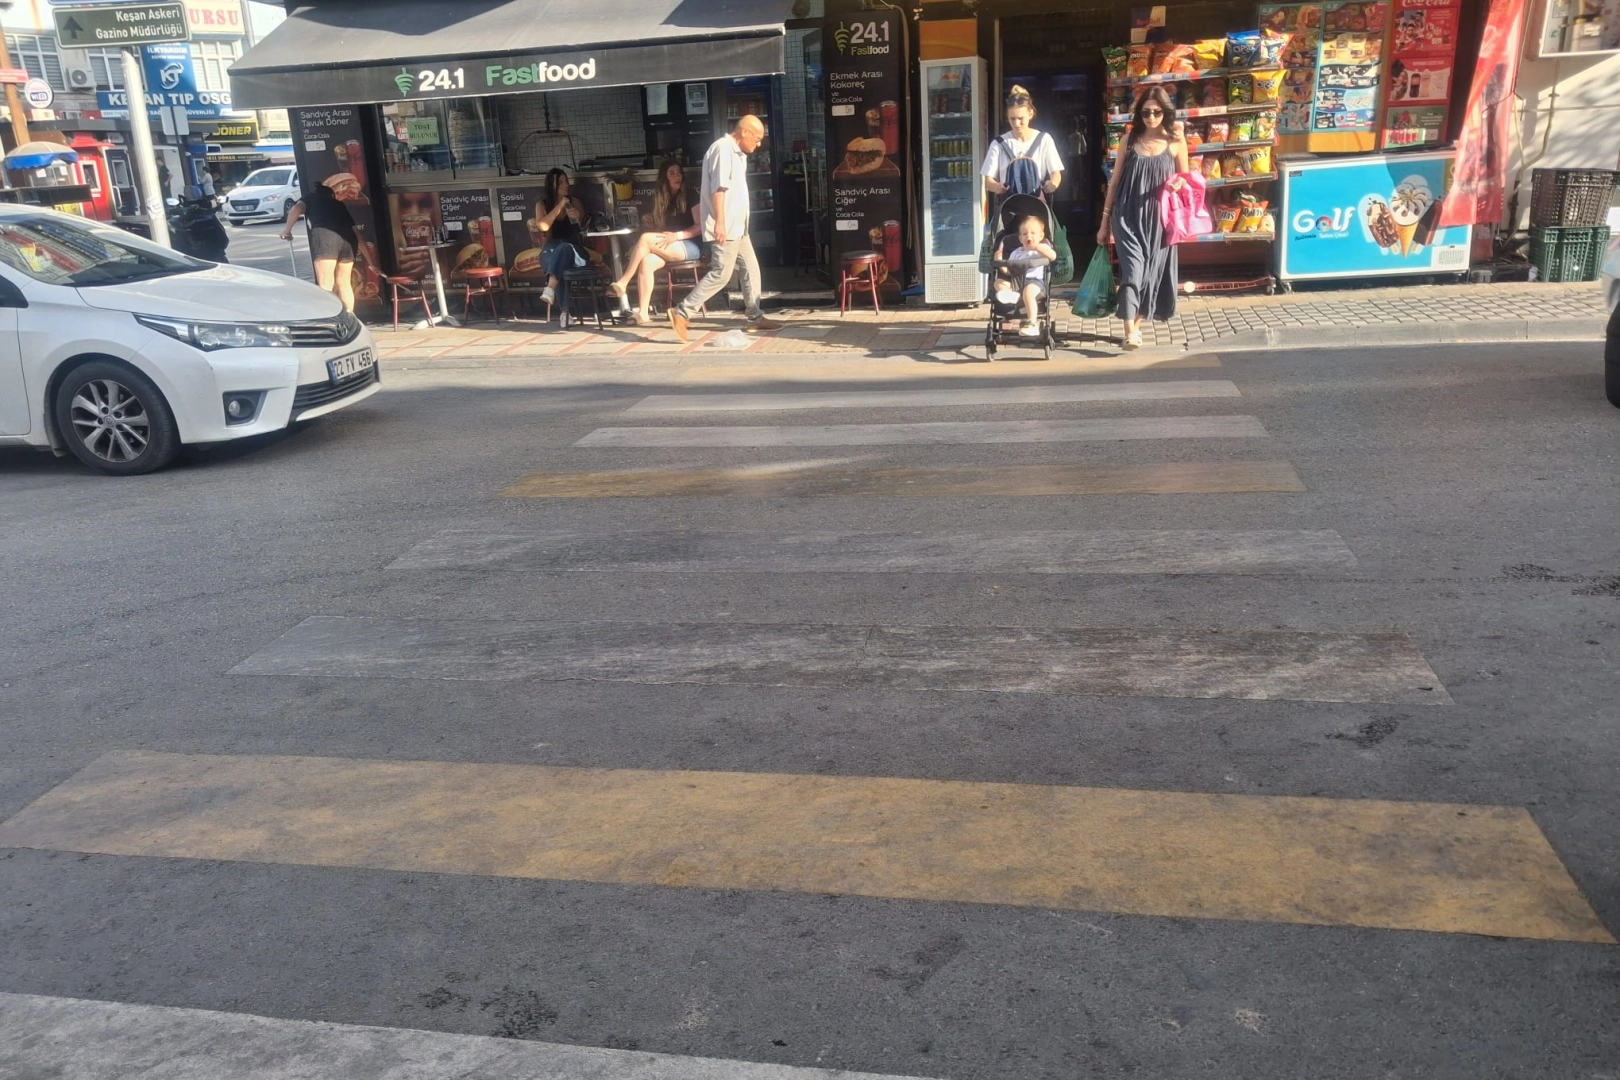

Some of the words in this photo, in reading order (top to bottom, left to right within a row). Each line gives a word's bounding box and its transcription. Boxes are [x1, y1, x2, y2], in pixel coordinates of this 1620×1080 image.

[116, 11, 146, 24] Keşan
[149, 7, 180, 19] Askeri
[96, 28, 128, 39] Gazino
[130, 23, 183, 38] Müdürlüğü
[850, 21, 890, 44] 24.1
[851, 44, 890, 56] Fastfood
[418, 67, 465, 92] 24.1
[485, 57, 596, 86] Fastfood
[830, 71, 859, 81] Ekmek
[861, 70, 883, 79] Arası
[830, 81, 865, 89] Kokoreç
[108, 93, 165, 106] KEAN
[168, 93, 194, 105] TIP
[831, 96, 863, 104] Coca-Cola
[300, 110, 331, 120] Sandviç
[332, 109, 352, 117] Arası
[301, 119, 325, 128] Tavuk
[326, 117, 350, 126] Döner
[834, 187, 867, 197] Sandviç
[869, 186, 891, 195] Arası
[440, 195, 469, 204] Sandviç
[470, 194, 489, 202] Arası
[500, 194, 525, 202] Sosisli
[835, 196, 857, 206] Ciğer
[441, 204, 461, 212] Ciğer
[1292, 206, 1356, 233] Golf
